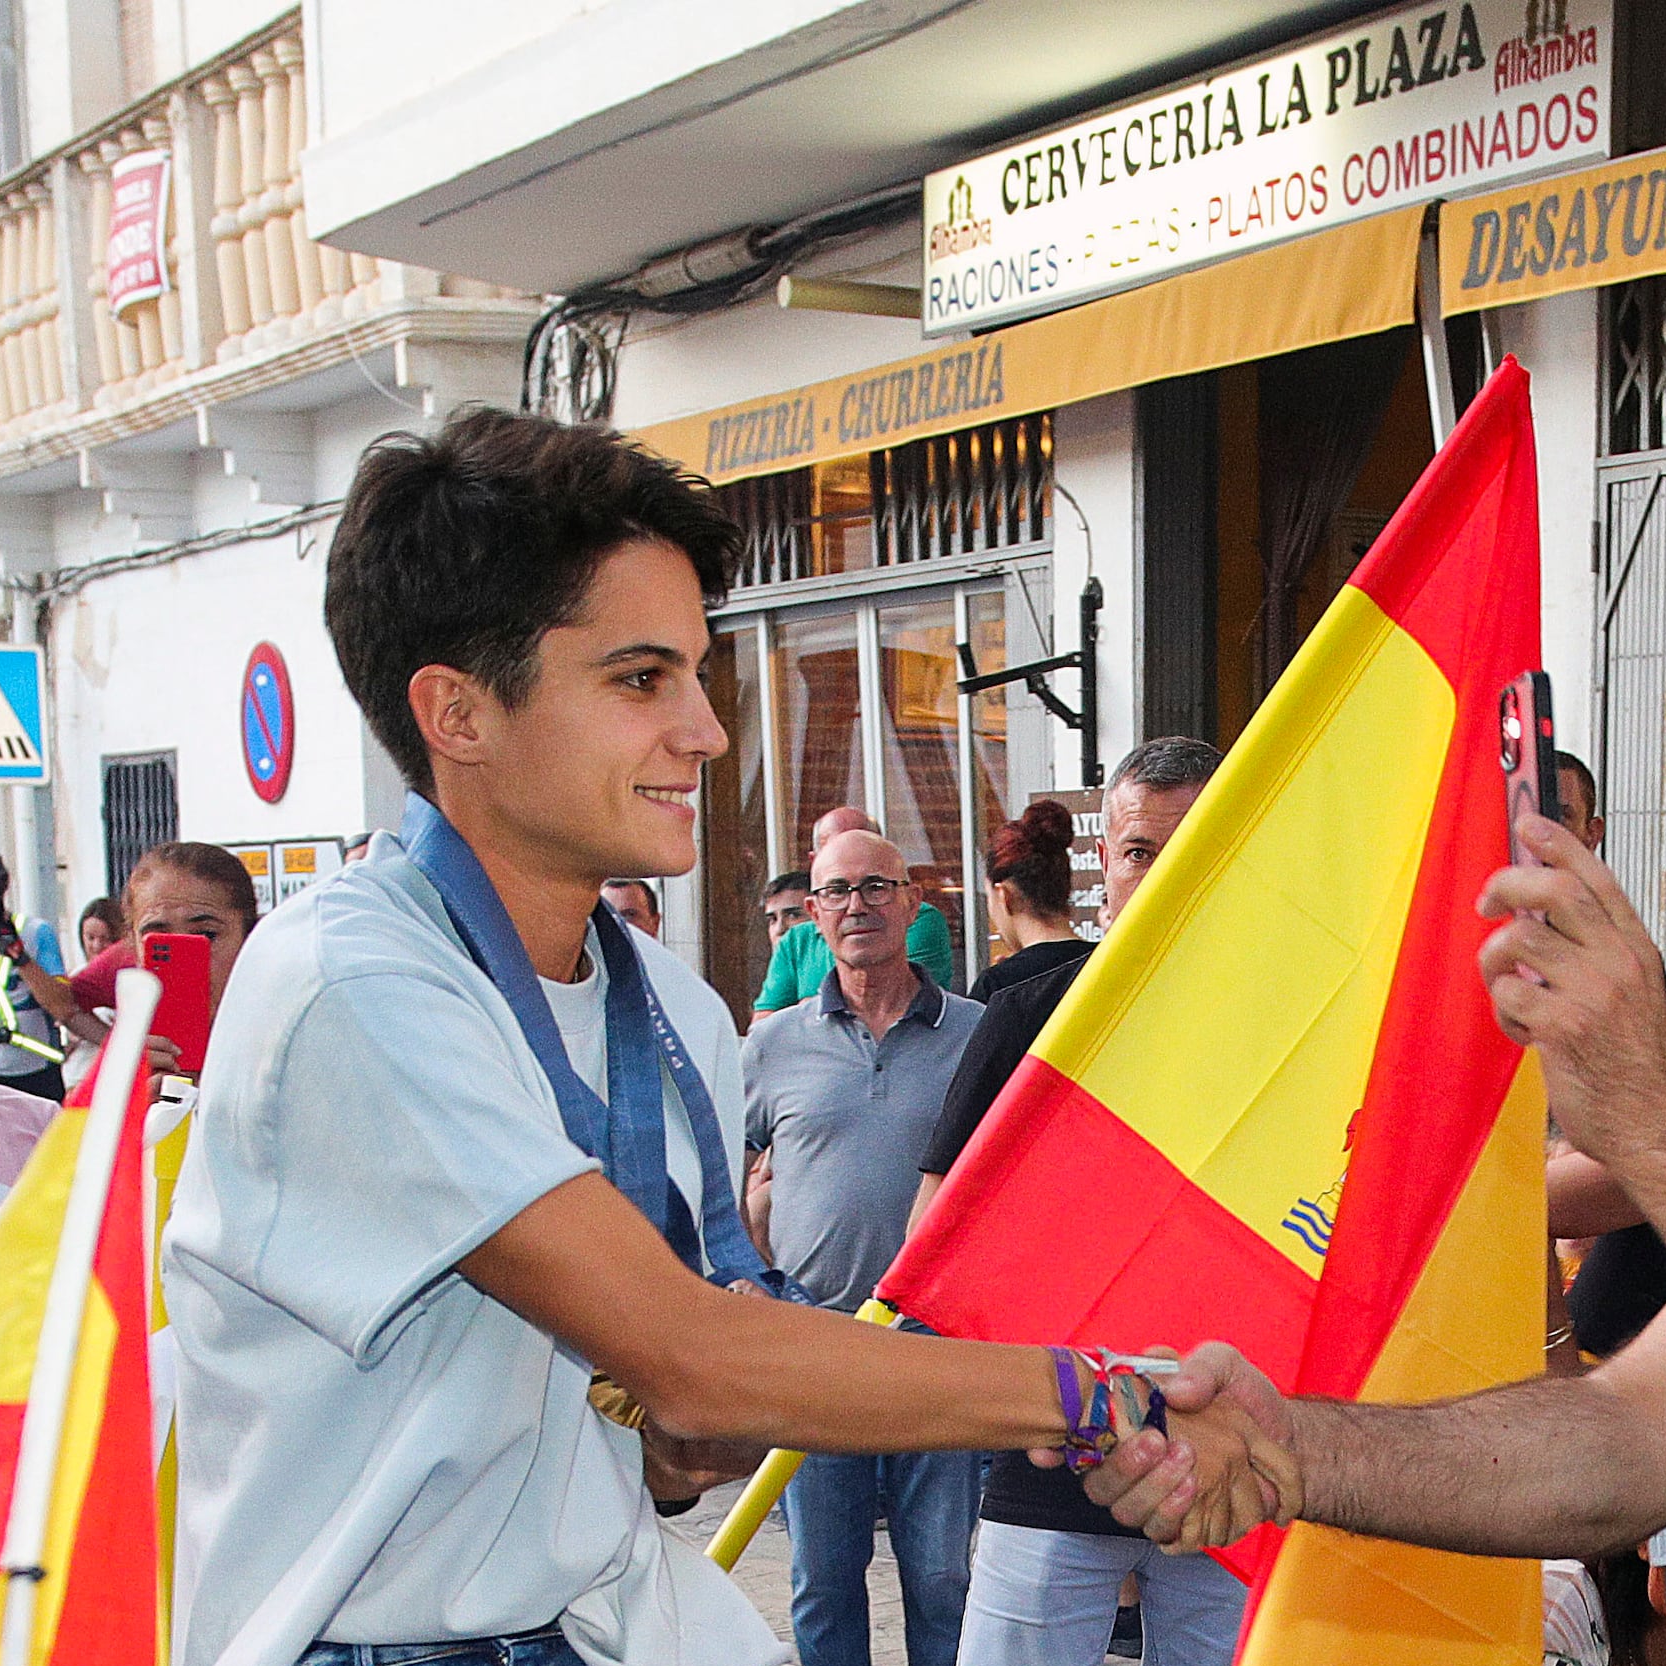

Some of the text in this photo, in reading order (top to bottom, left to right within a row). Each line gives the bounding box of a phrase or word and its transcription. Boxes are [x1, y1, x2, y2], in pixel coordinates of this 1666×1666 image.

[1001, 1, 1487, 216] CERVECERÍA LA PLAZA
[1495, 24, 1598, 95] Alhambra
[930, 85, 1599, 321] RACIONES PZZAS PLATOS COMBINADOS
[705, 335, 1005, 474] PIZZERÍA CHURRERÍA
